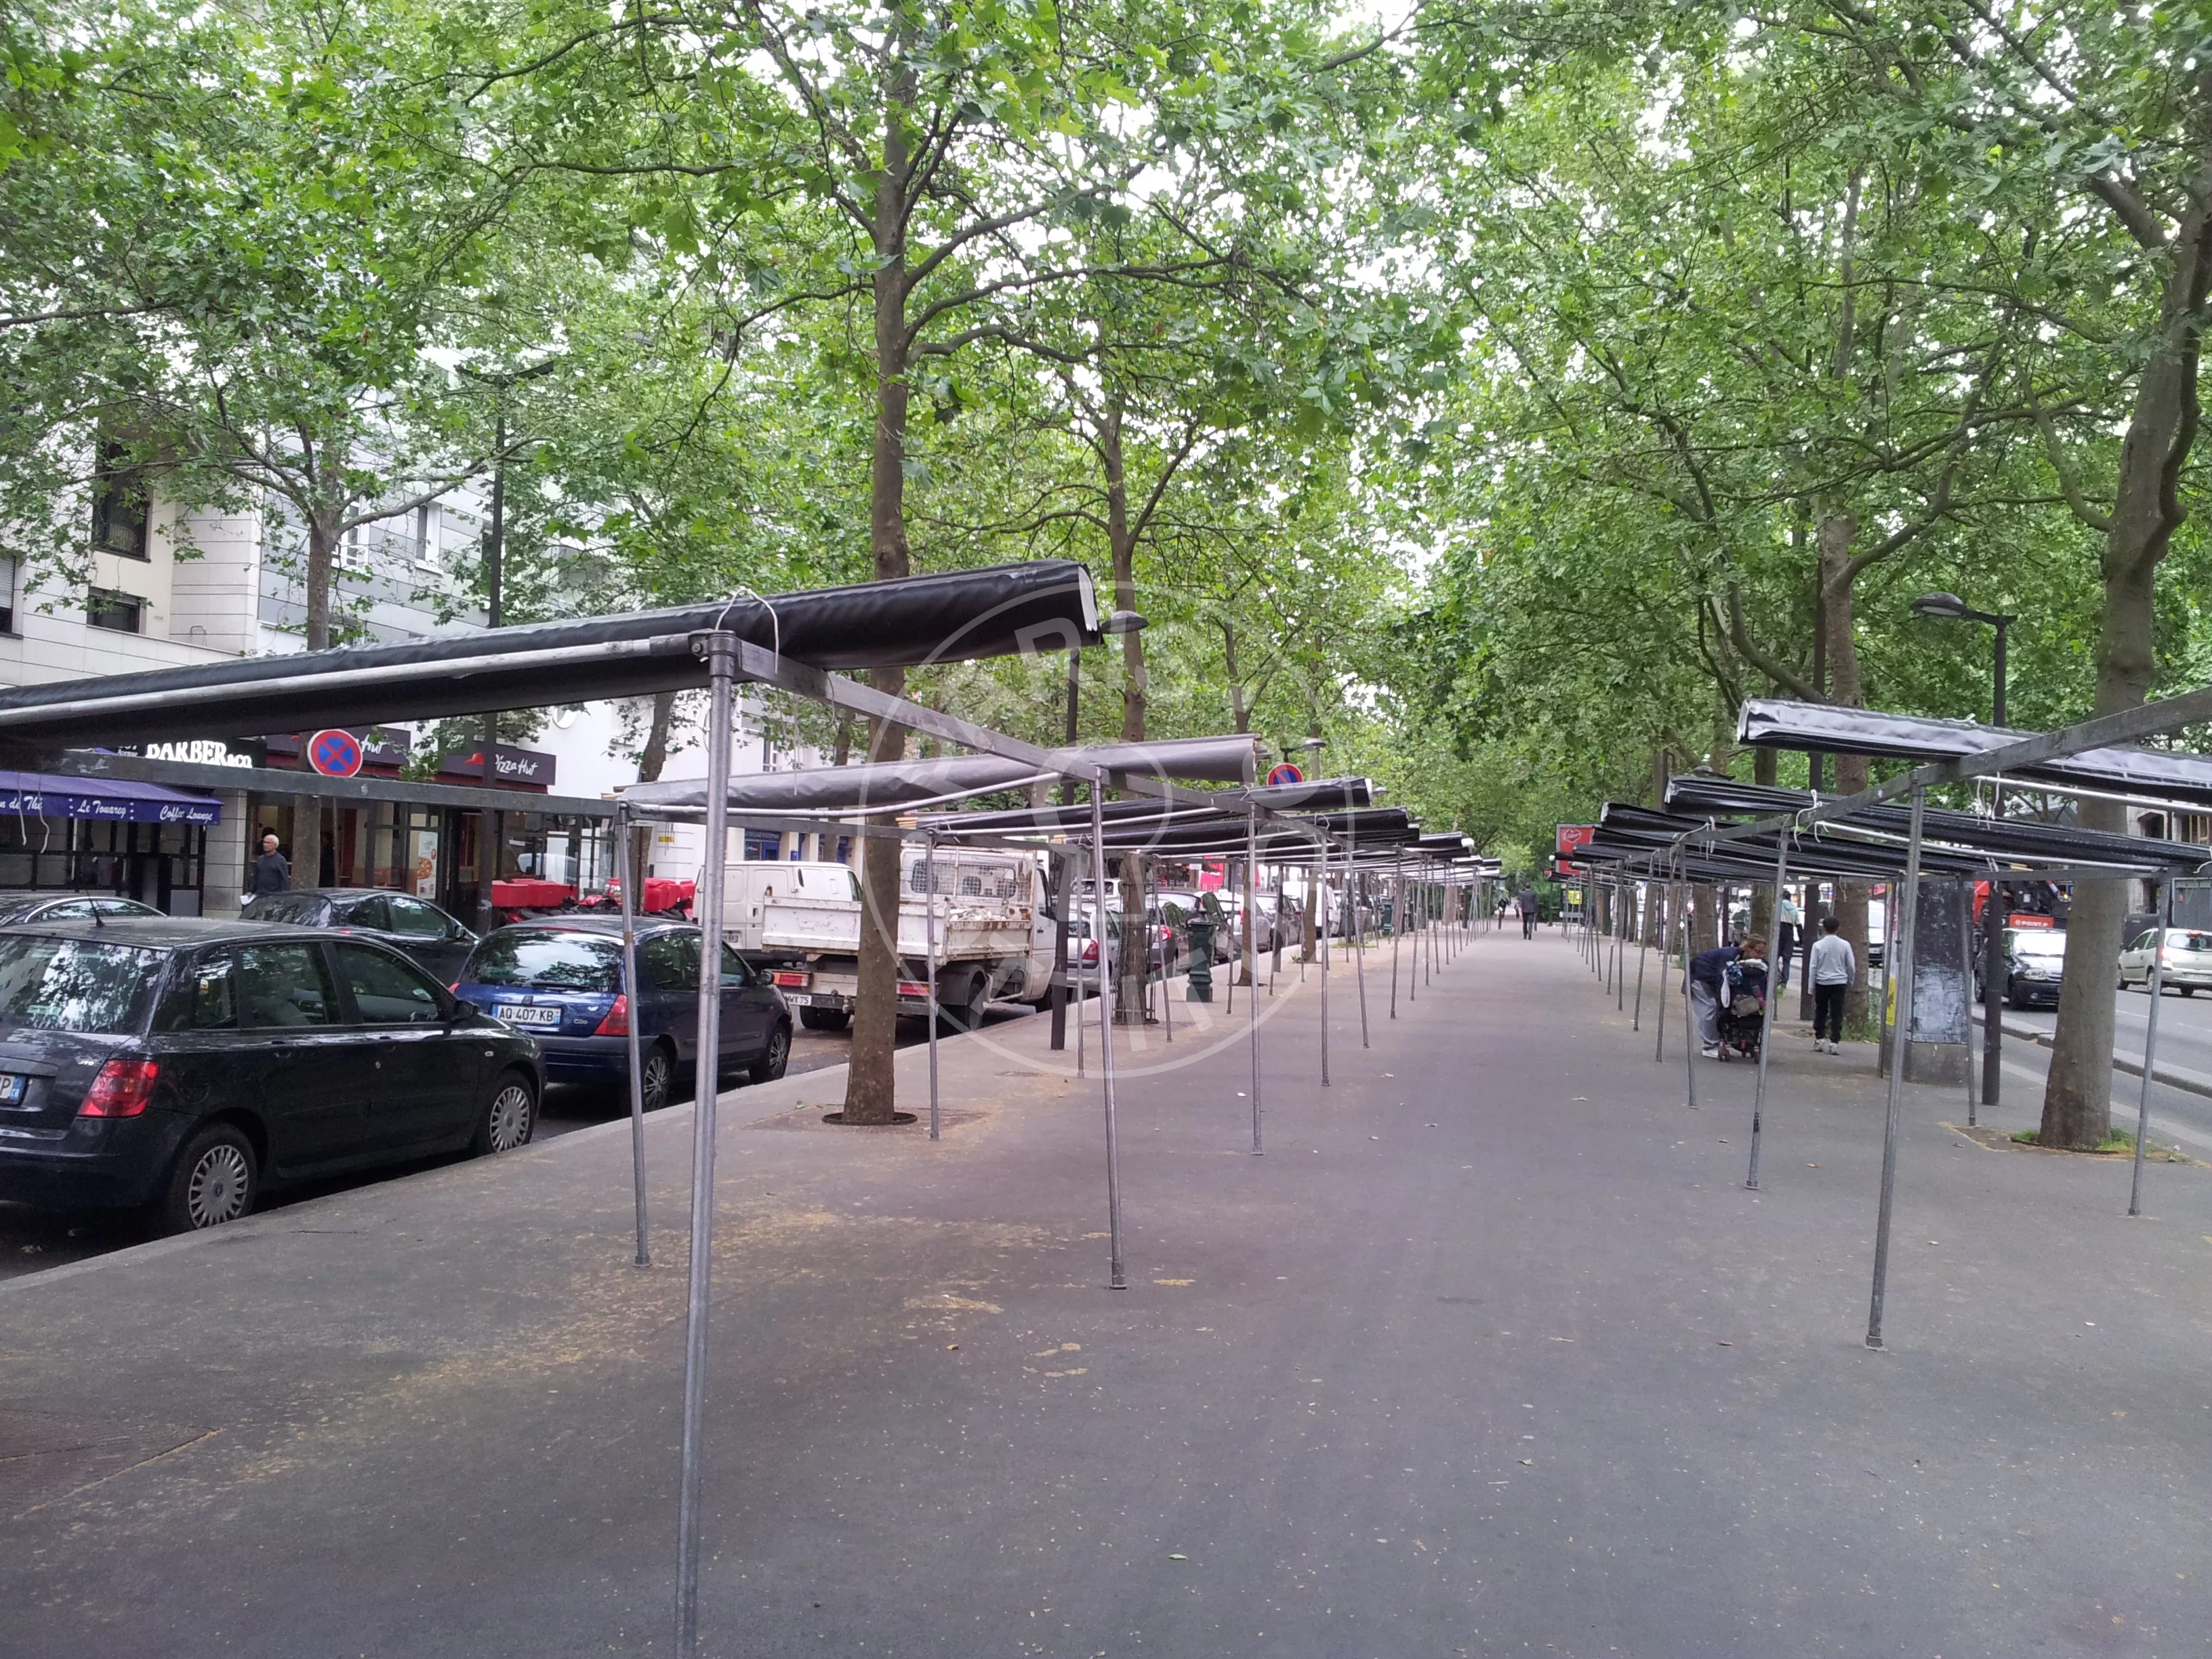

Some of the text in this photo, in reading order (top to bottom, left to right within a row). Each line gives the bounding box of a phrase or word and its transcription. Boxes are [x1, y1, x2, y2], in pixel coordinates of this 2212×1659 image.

[518, 758, 539, 776] Hut
[77, 799, 127, 819] Le Touareg
[159, 805, 213, 824] Coffee Lounge
[800, 996, 809, 1004] 75
[499, 1008, 512, 1019] AQ
[516, 1008, 536, 1021] 407
[539, 1010, 554, 1022] KB
[0, 1077, 11, 1097] P
